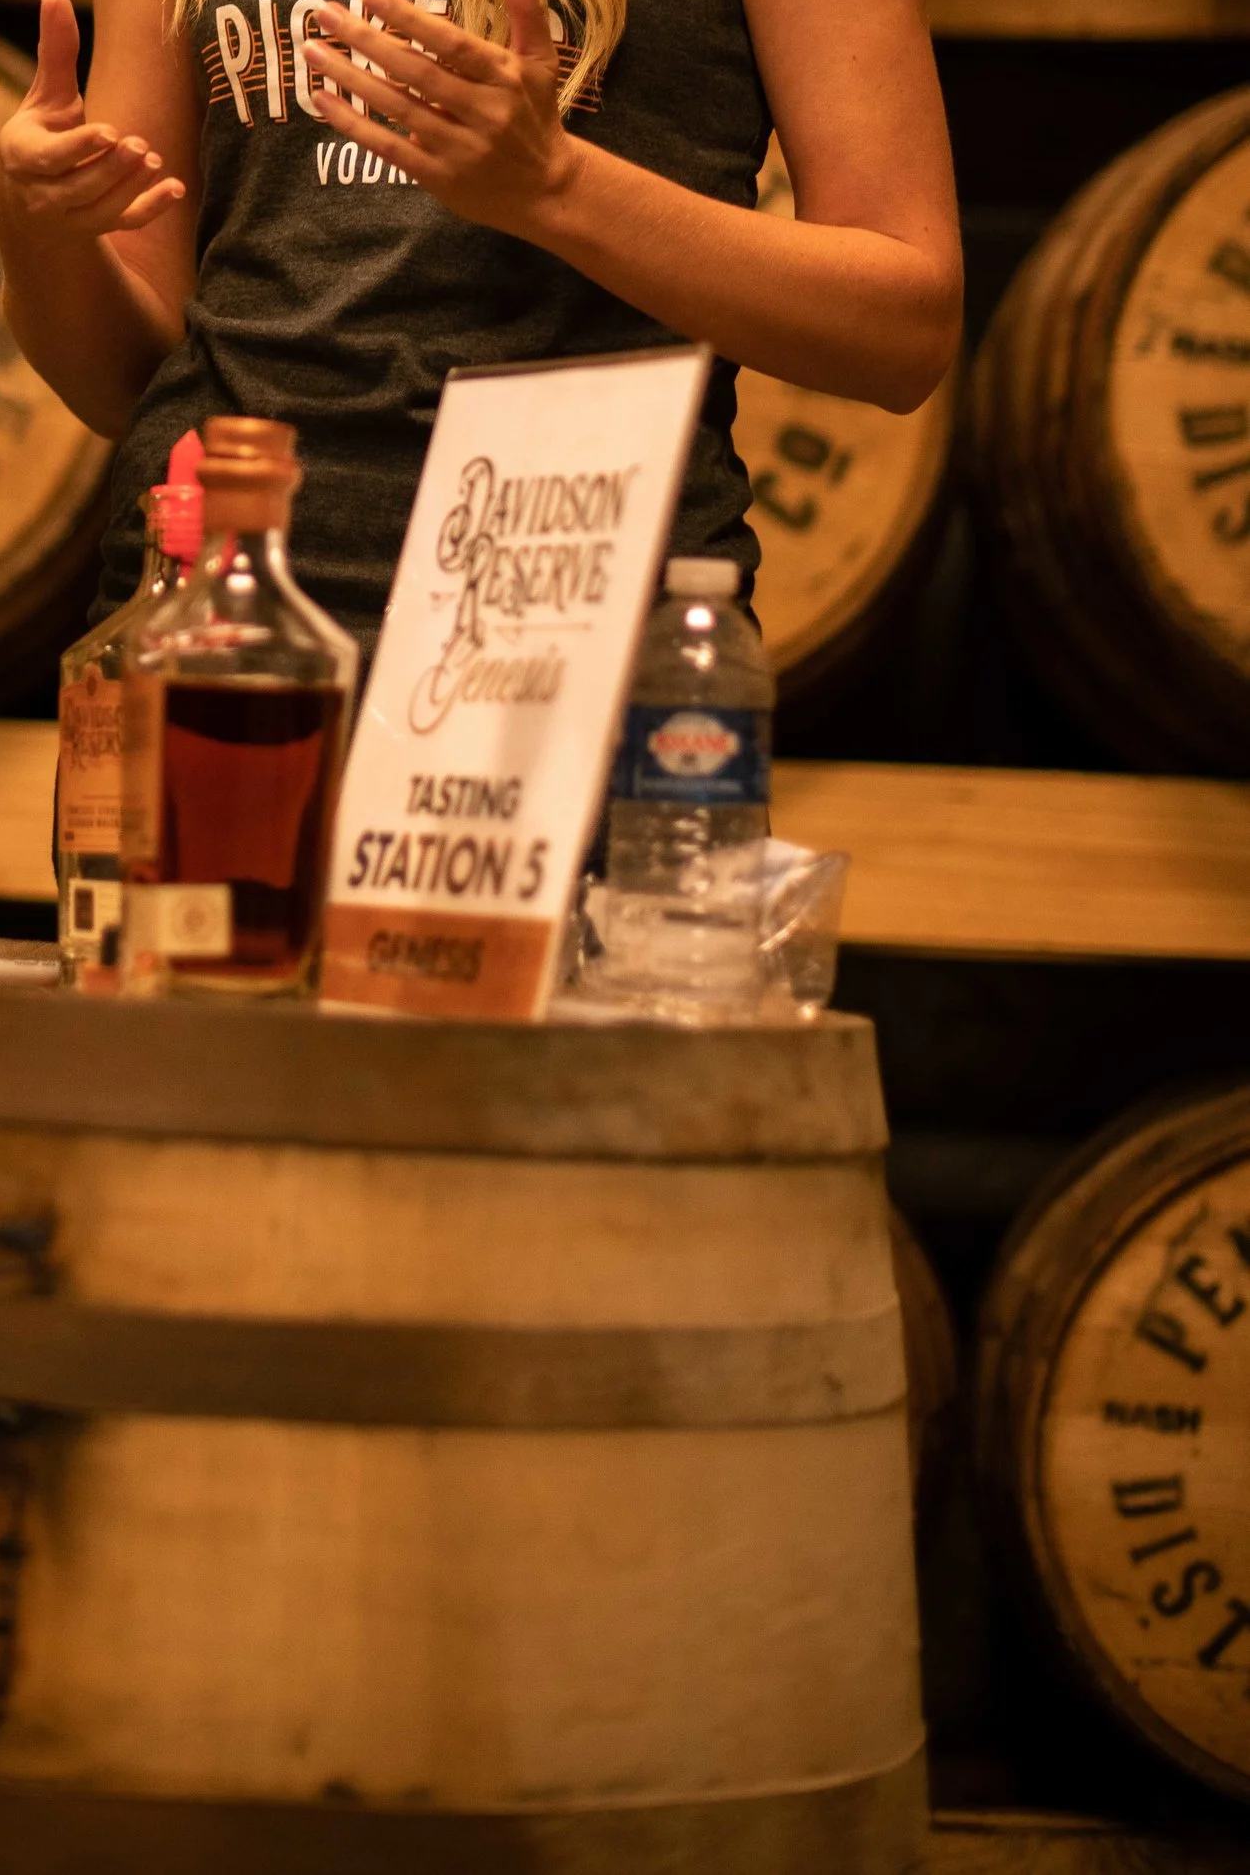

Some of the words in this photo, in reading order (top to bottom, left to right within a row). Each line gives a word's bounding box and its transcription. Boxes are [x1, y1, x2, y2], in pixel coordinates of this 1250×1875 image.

[438, 456, 640, 571] DAVIDSON
[452, 530, 614, 649] RESERVE
[406, 774, 523, 821] TASTING
[347, 828, 516, 898] STATION
[518, 838, 551, 902] 5
